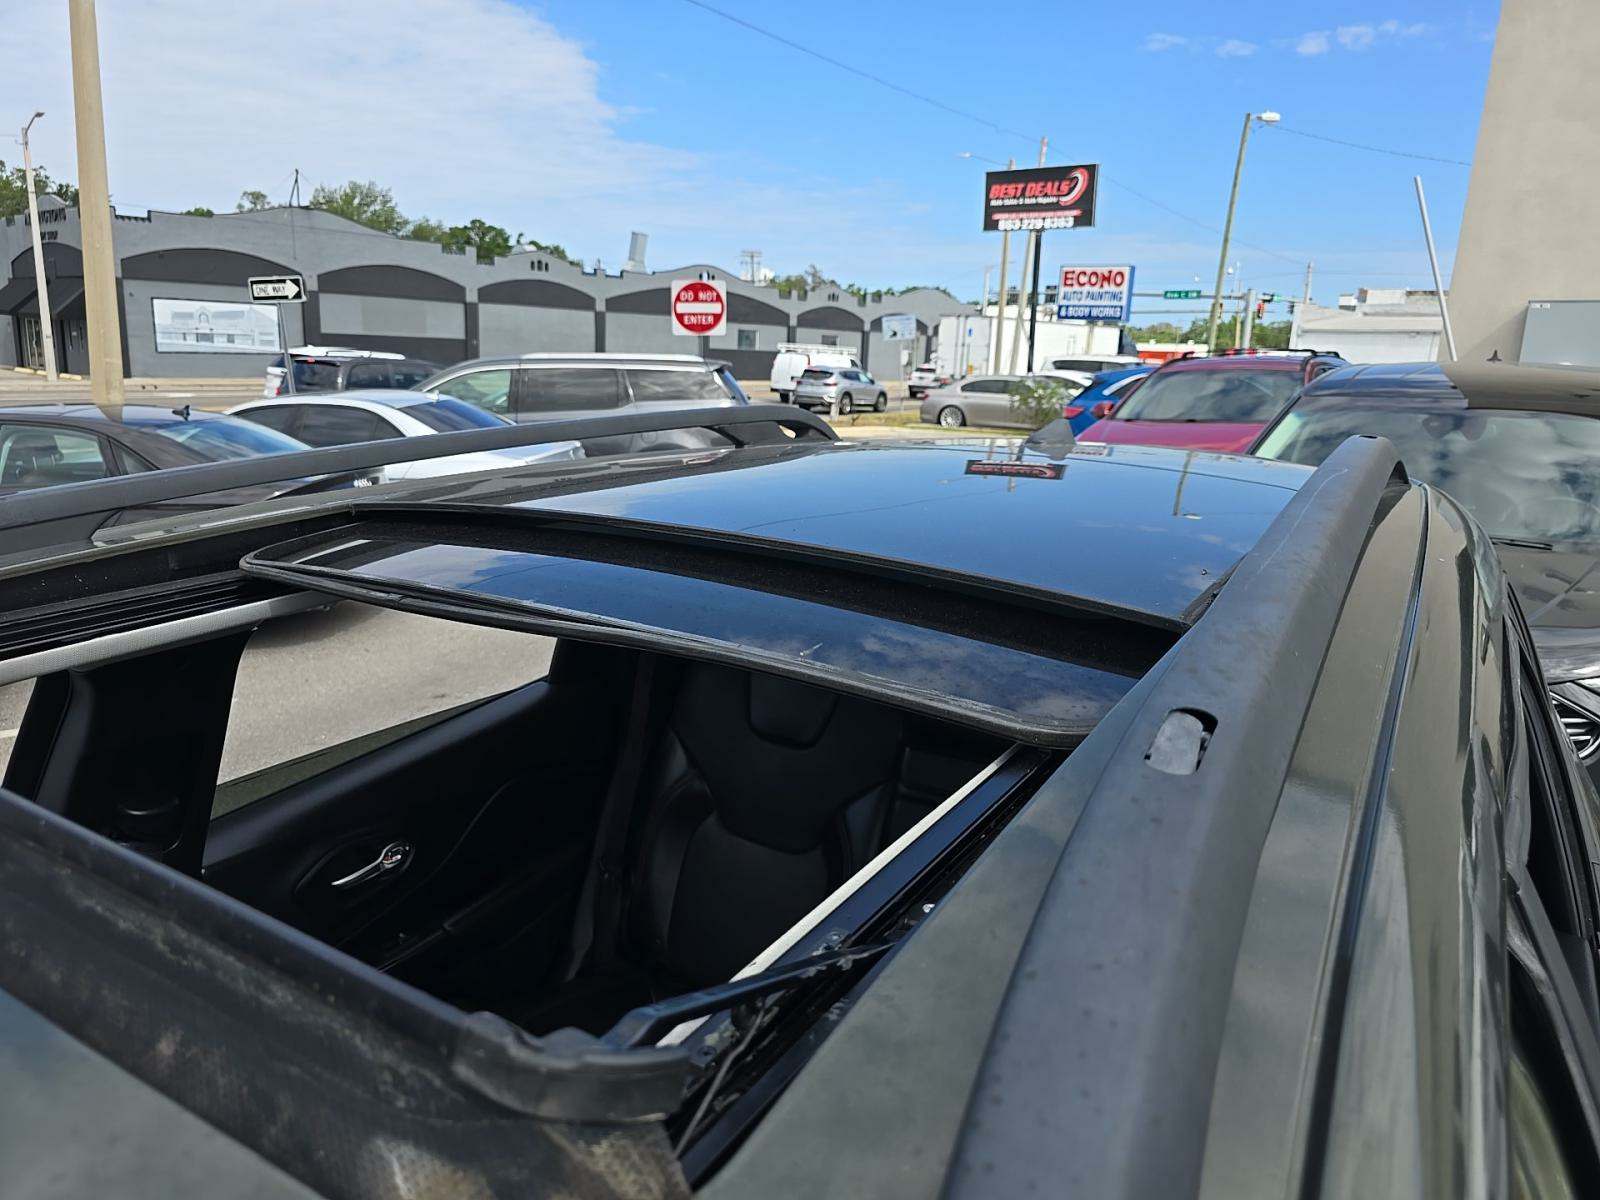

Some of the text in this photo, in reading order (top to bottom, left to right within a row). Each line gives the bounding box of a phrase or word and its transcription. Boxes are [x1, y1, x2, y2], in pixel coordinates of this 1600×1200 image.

[989, 180, 1072, 200] BEST DEALS
[1063, 270, 1125, 288] ECONO
[255, 284, 286, 296] ONE WAY
[680, 290, 717, 302] DO NOT
[1063, 290, 1123, 301] AUTO PAINTING
[1068, 306, 1091, 317] BODY
[1090, 306, 1121, 317] WORKS
[683, 315, 714, 325] ENTER
